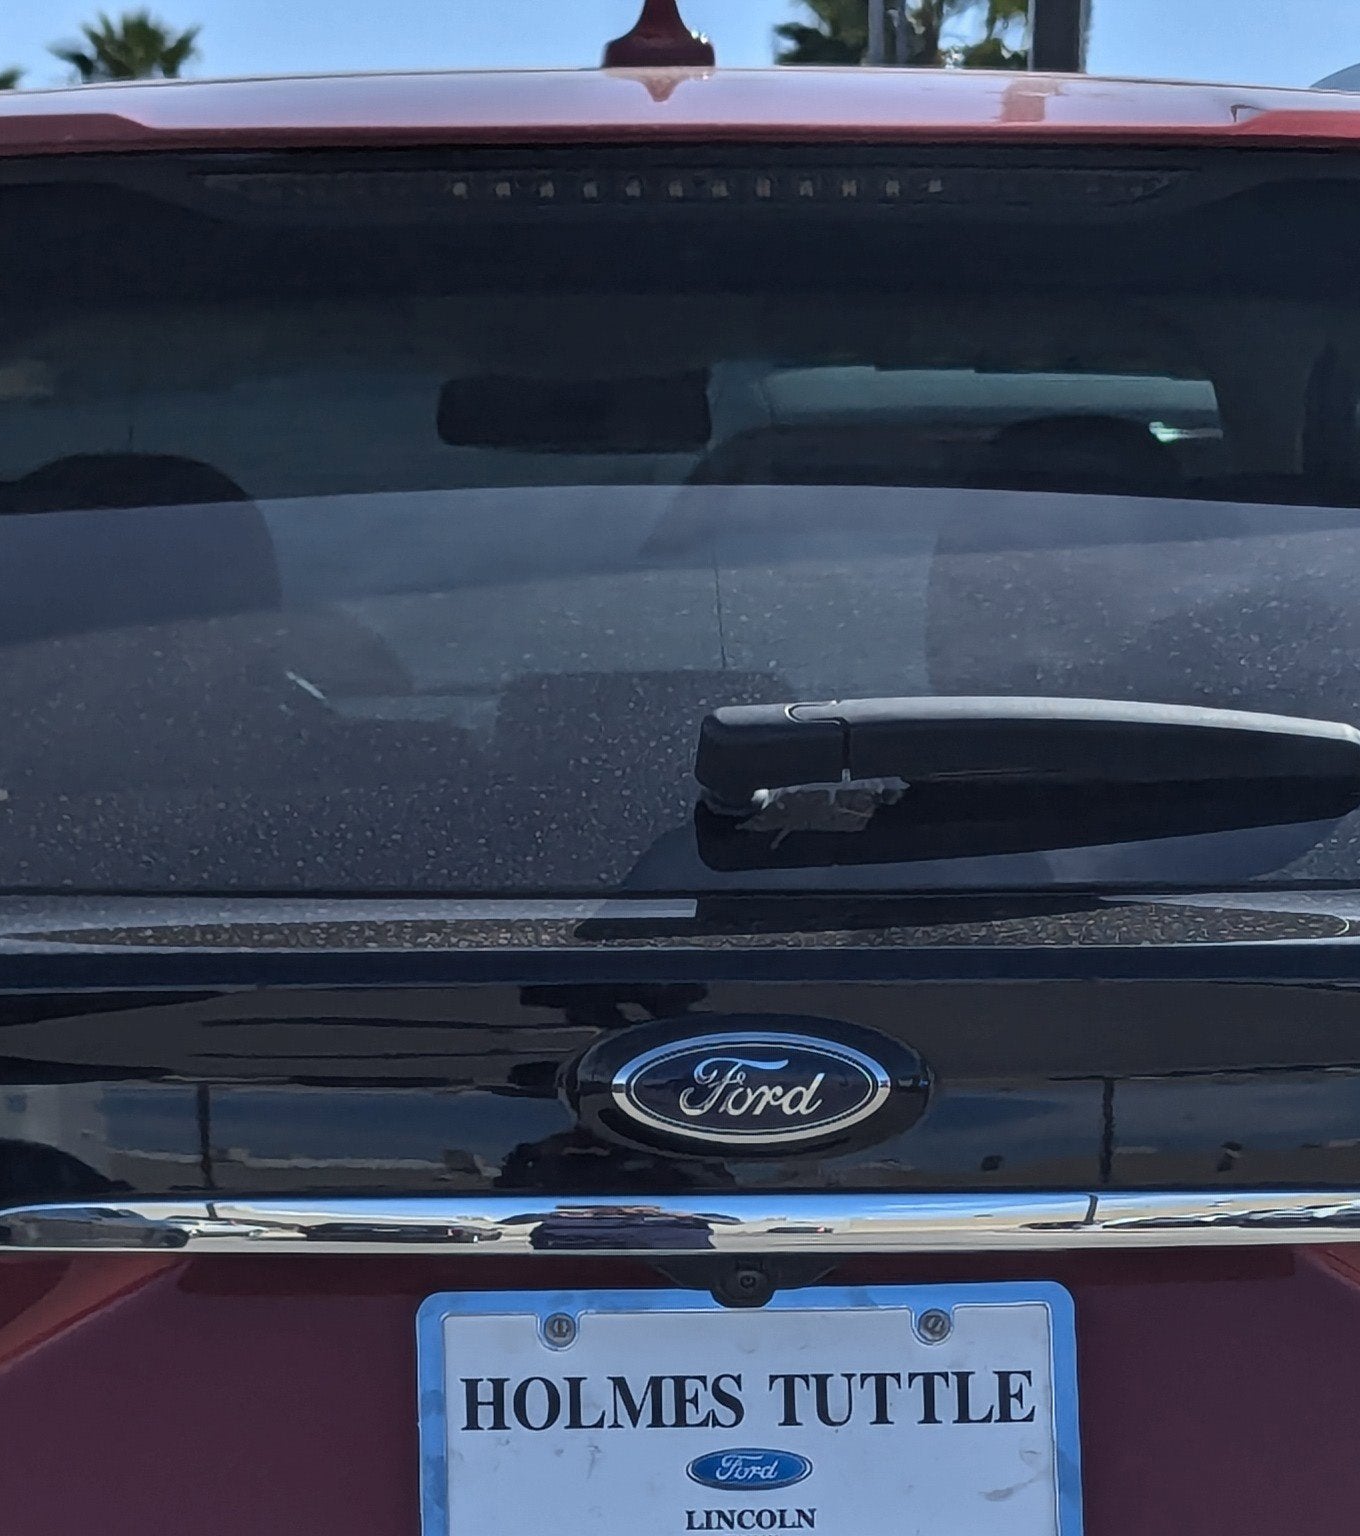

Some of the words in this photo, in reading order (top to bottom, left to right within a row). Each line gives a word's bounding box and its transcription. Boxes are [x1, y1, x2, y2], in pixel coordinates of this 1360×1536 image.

[679, 1057, 825, 1116] Ford
[460, 1373, 745, 1431] HOLMES
[769, 1370, 1036, 1427] TUTTLE
[715, 1454, 779, 1480] Ford
[685, 1508, 817, 1531] LINCOLN
